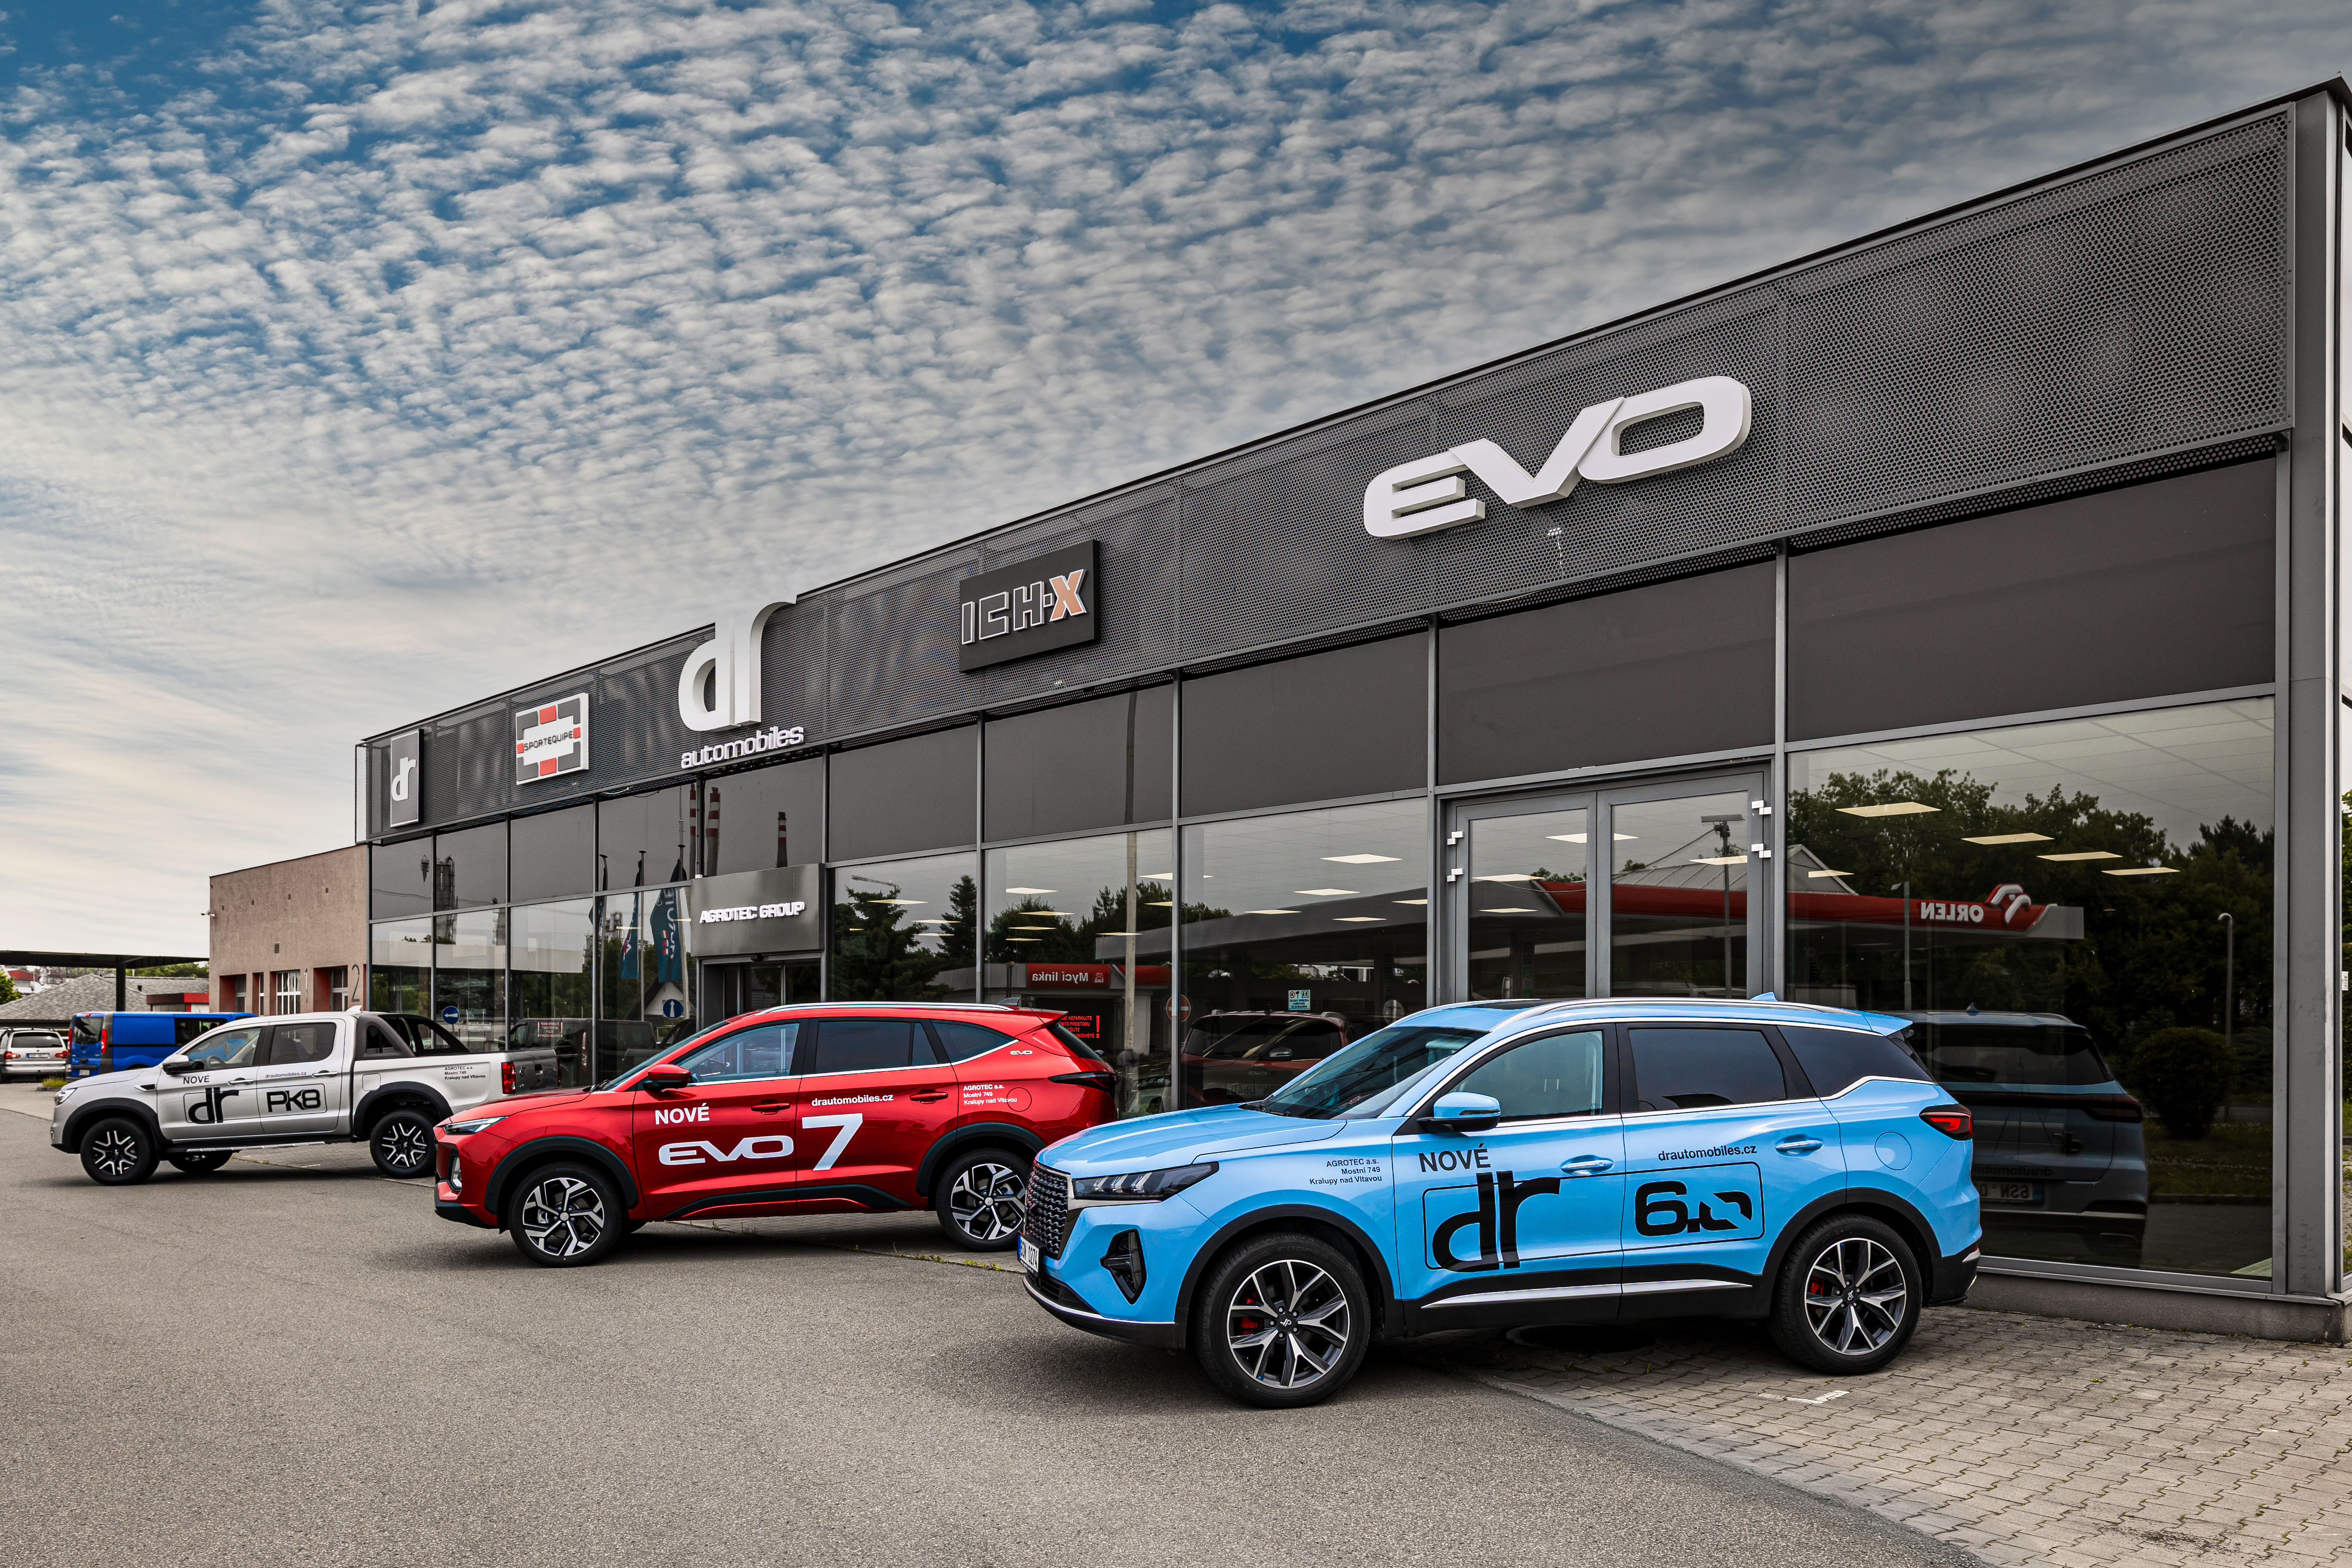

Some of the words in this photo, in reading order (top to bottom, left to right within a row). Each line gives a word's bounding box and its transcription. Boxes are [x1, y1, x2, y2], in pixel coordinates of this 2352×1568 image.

[1364, 376, 1752, 539] EVO
[962, 569, 1087, 645] ICH-X
[678, 595, 797, 731] dr
[524, 730, 573, 751] SPORTEQUIPE
[681, 726, 804, 769] automobiles
[392, 757, 416, 801] dr
[699, 906, 757, 923] AGROTEC
[760, 901, 805, 919] GROUP
[183, 1074, 210, 1084] NOVÉ
[188, 1087, 239, 1124] dr
[266, 1089, 321, 1112] PK8
[812, 1094, 894, 1106] drautomobiles.cz
[655, 1102, 710, 1125] NOVÉ
[658, 1135, 794, 1166] EVO
[802, 1113, 863, 1171] 7
[1658, 1145, 1757, 1161] drautomobiles.cz
[1326, 1158, 1364, 1167] AGROTEC
[1419, 1143, 1491, 1173] NOVÉ
[1432, 1170, 1561, 1273] dr
[1029, 1245, 1037, 1268] 0274
[1278, 1246, 1329, 1260] COOPER
